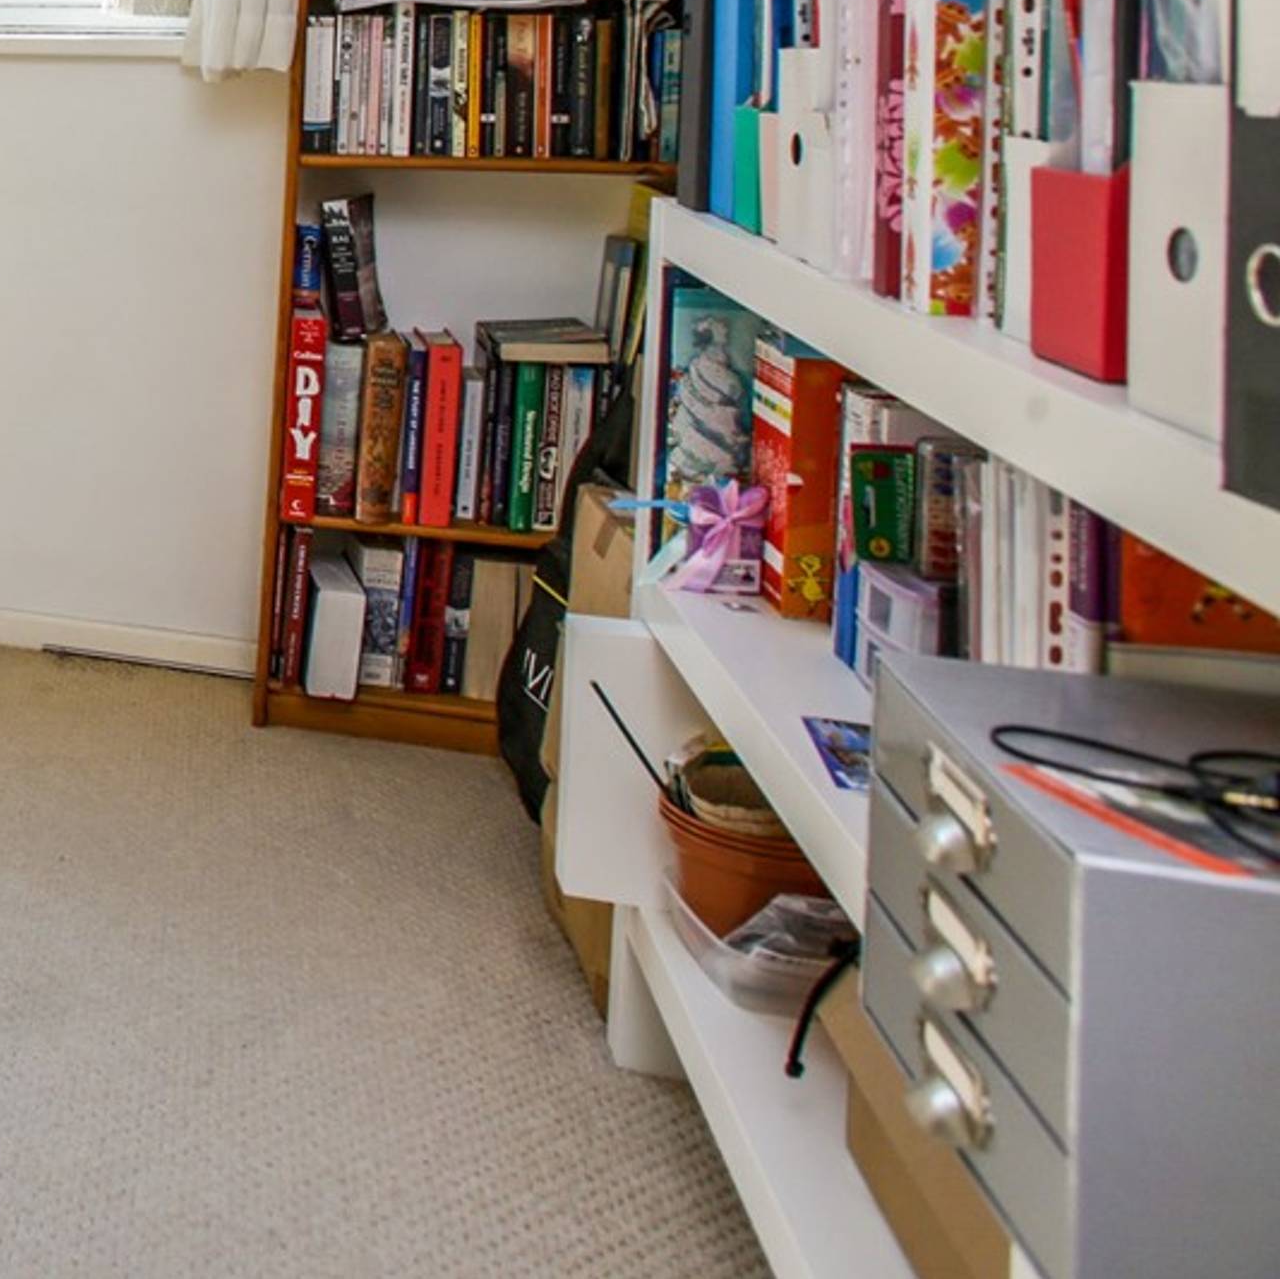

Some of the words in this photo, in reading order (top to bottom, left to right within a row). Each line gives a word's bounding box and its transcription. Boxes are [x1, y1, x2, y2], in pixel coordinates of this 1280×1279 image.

[301, 235, 317, 288] German
[290, 365, 321, 462] DIY
[524, 410, 536, 459] Structured
[519, 461, 532, 493] Design
